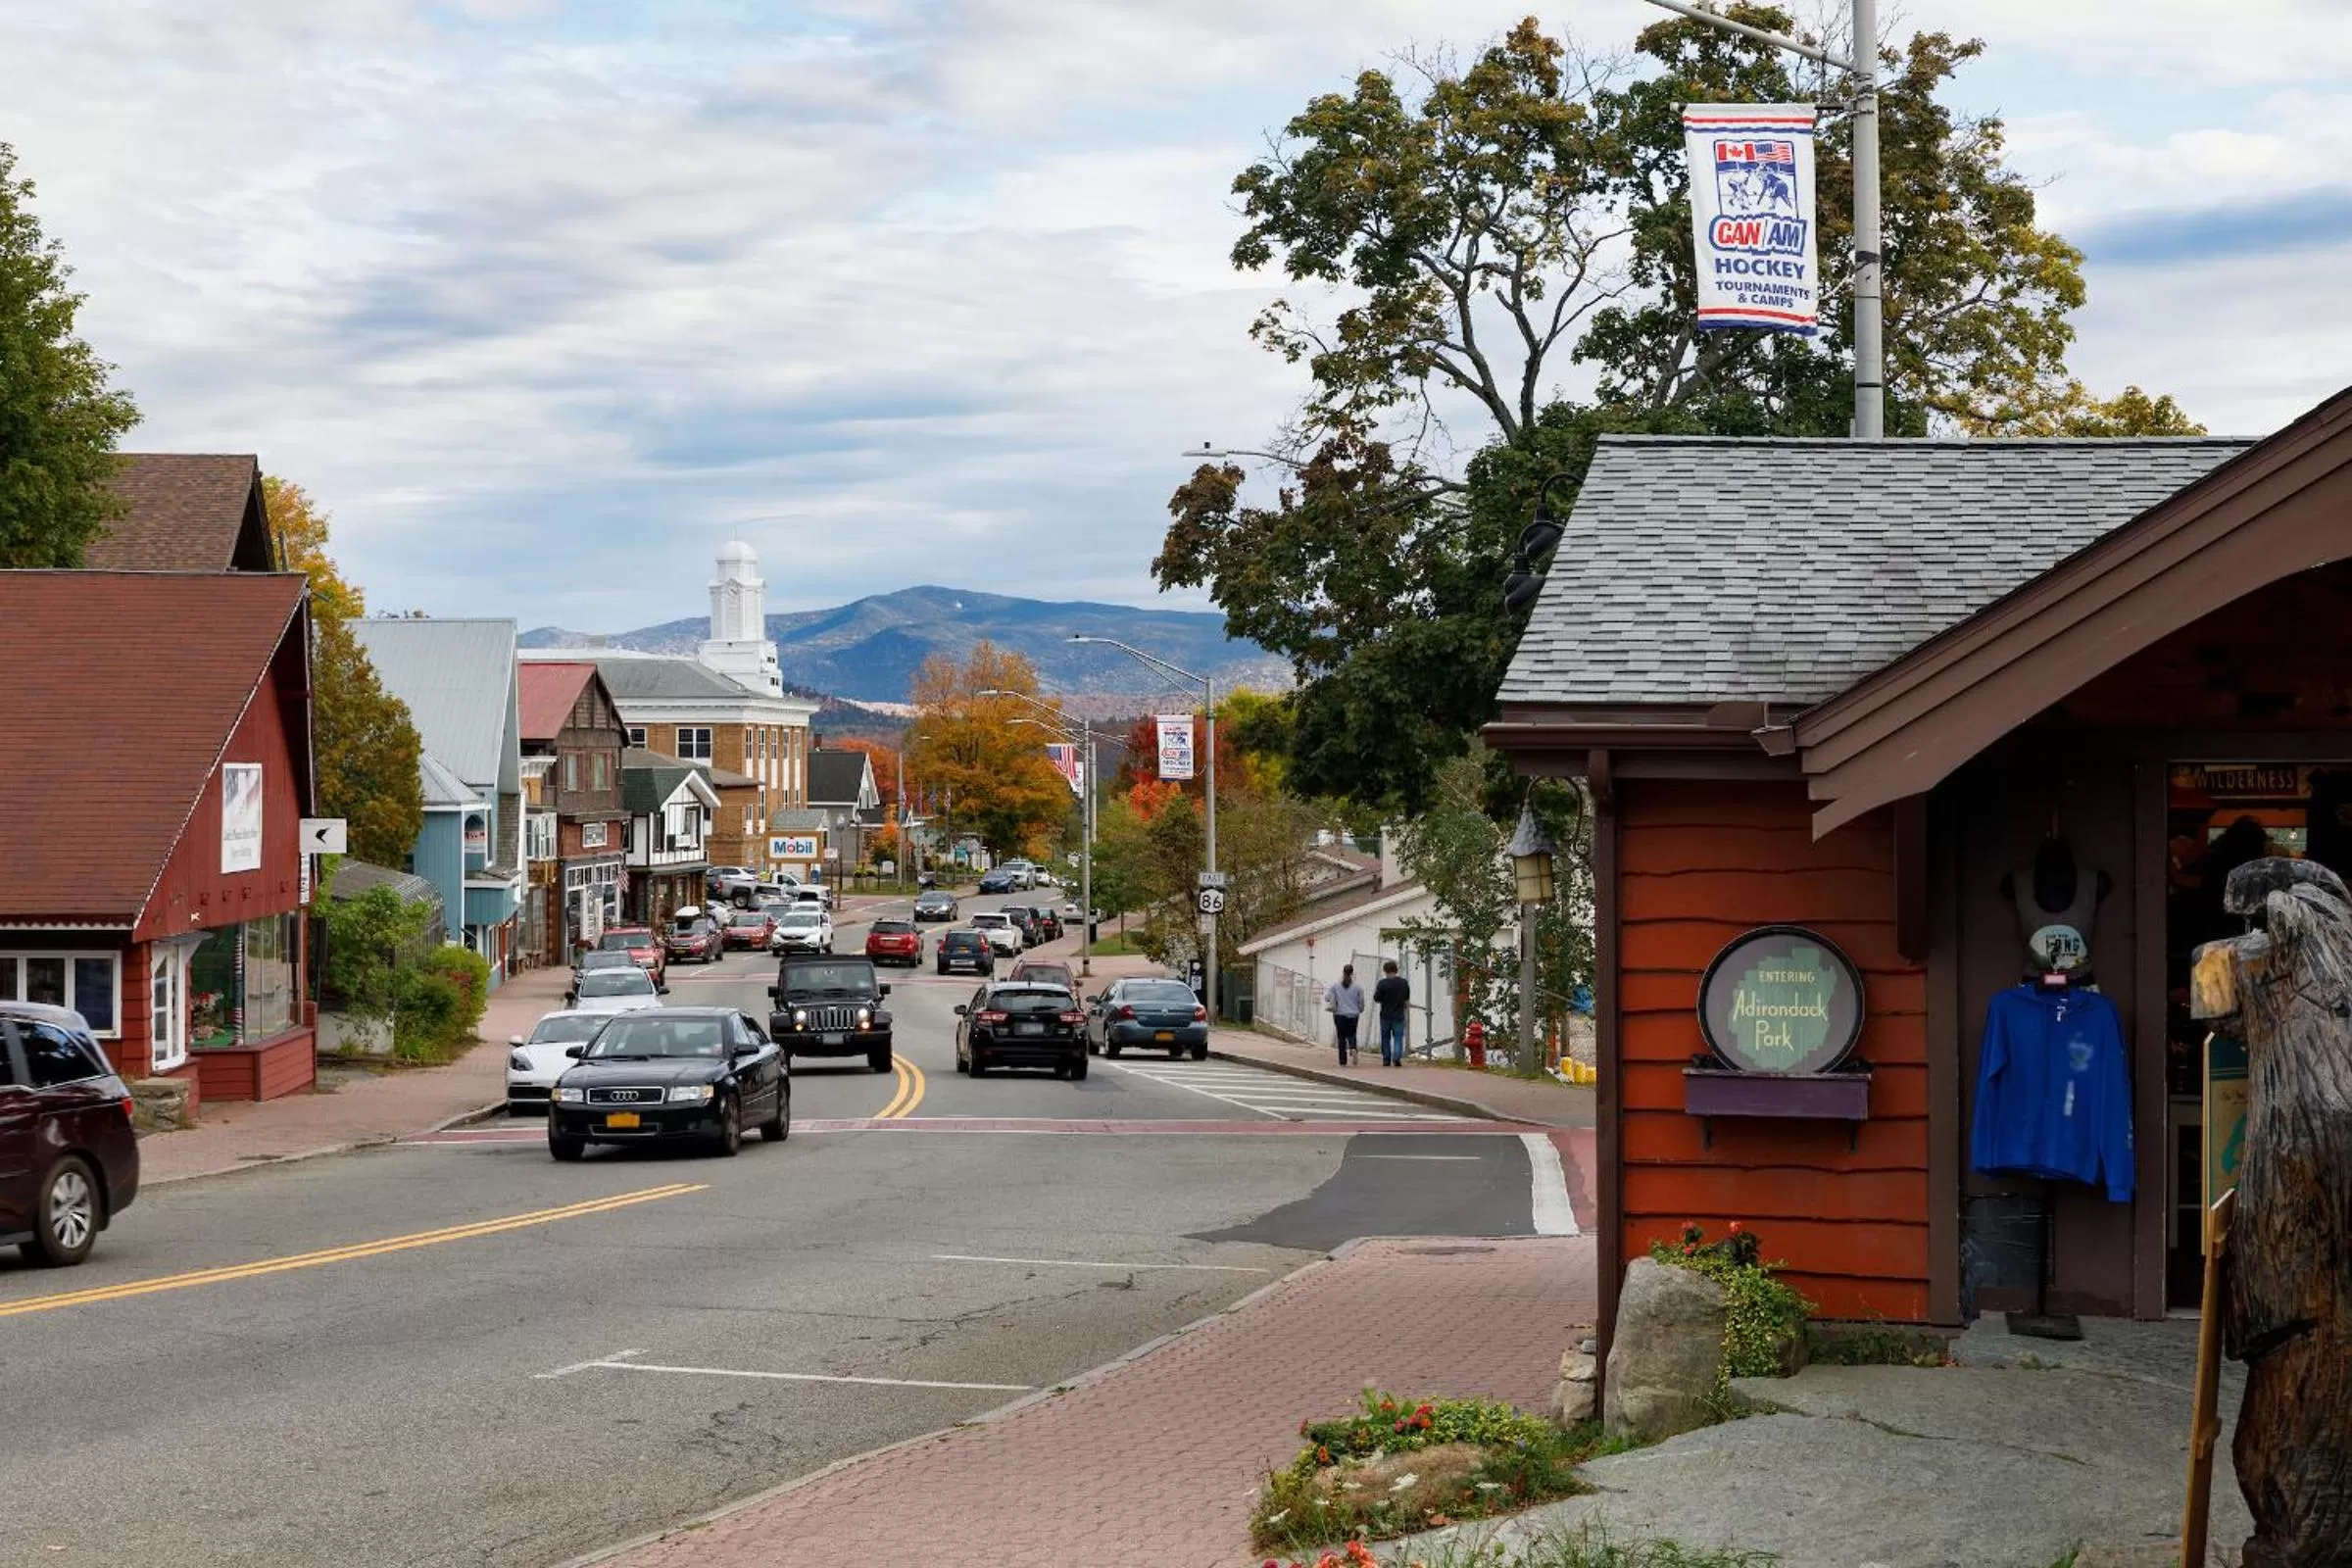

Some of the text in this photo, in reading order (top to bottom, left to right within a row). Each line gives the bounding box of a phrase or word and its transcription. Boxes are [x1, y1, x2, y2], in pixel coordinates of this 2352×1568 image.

[1716, 258, 1805, 279] HOCKEY
[1716, 281, 1810, 300] TOURNAMENTS
[1738, 294, 1794, 308] & CAMPS
[774, 841, 812, 854] Mobil
[1201, 895, 1222, 908] 86
[1759, 971, 1815, 983] ENTERING
[1733, 990, 1828, 1022] Adirondack
[1755, 1020, 1794, 1052] Park
